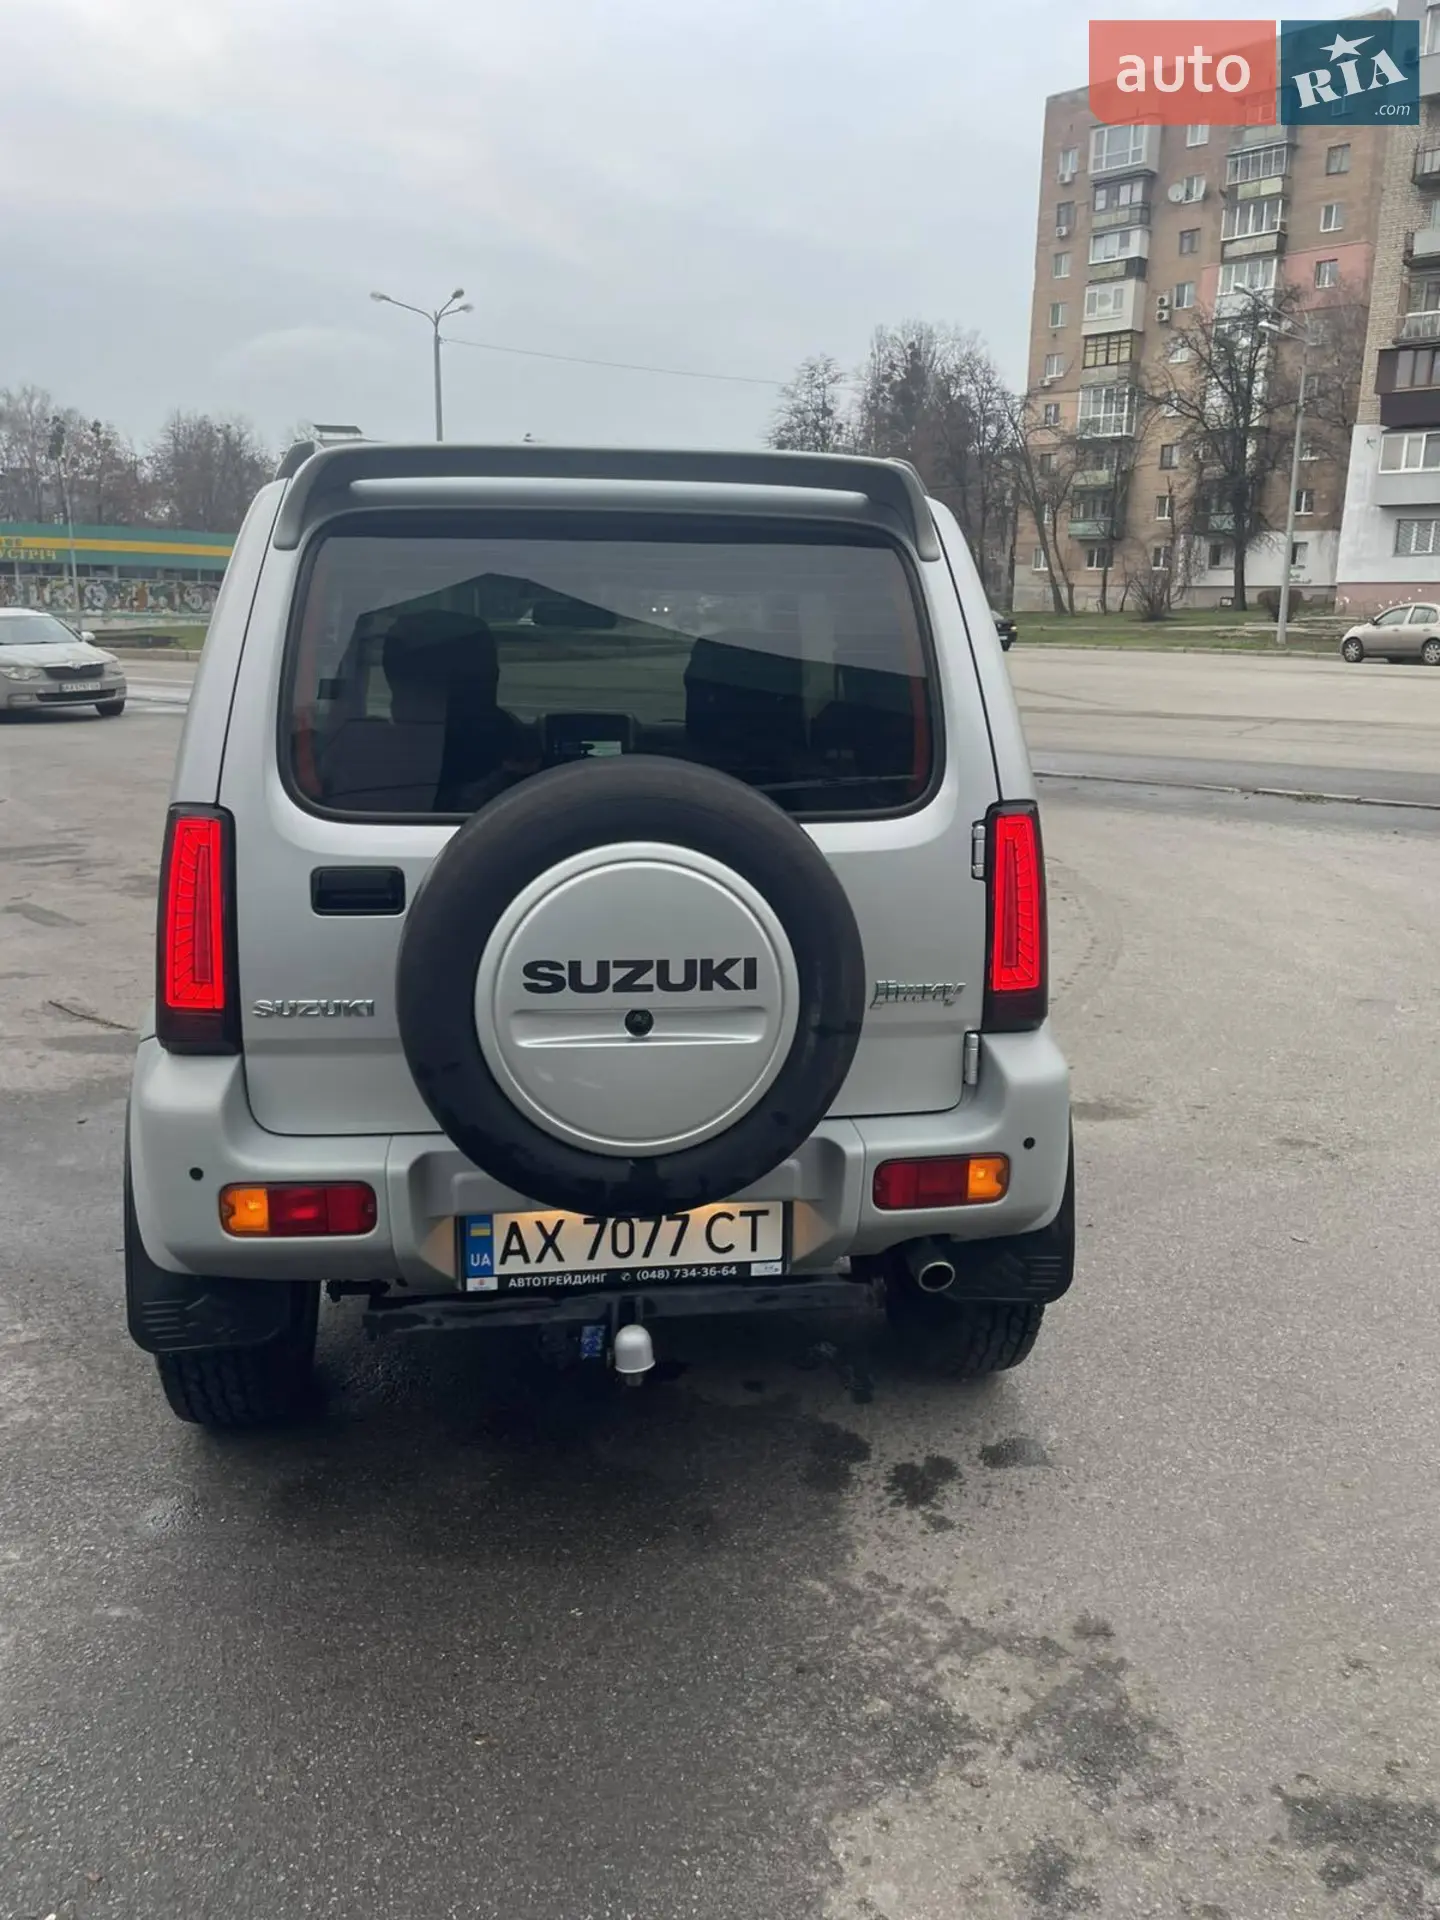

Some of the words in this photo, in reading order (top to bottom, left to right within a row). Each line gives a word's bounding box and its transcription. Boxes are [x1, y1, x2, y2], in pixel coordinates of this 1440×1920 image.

[522, 957, 757, 994] SUZUKI
[869, 979, 967, 1009] Jimny
[252, 999, 375, 1018] SUZUKI
[499, 1219, 565, 1266] AX
[583, 1213, 690, 1261] 7077
[705, 1210, 770, 1254] CT
[470, 1253, 492, 1267] UA
[508, 1273, 608, 1288] АВТОТРЕЙДИНГ
[636, 1269, 670, 1281] (048)
[674, 1266, 738, 1279] 734-36-64
